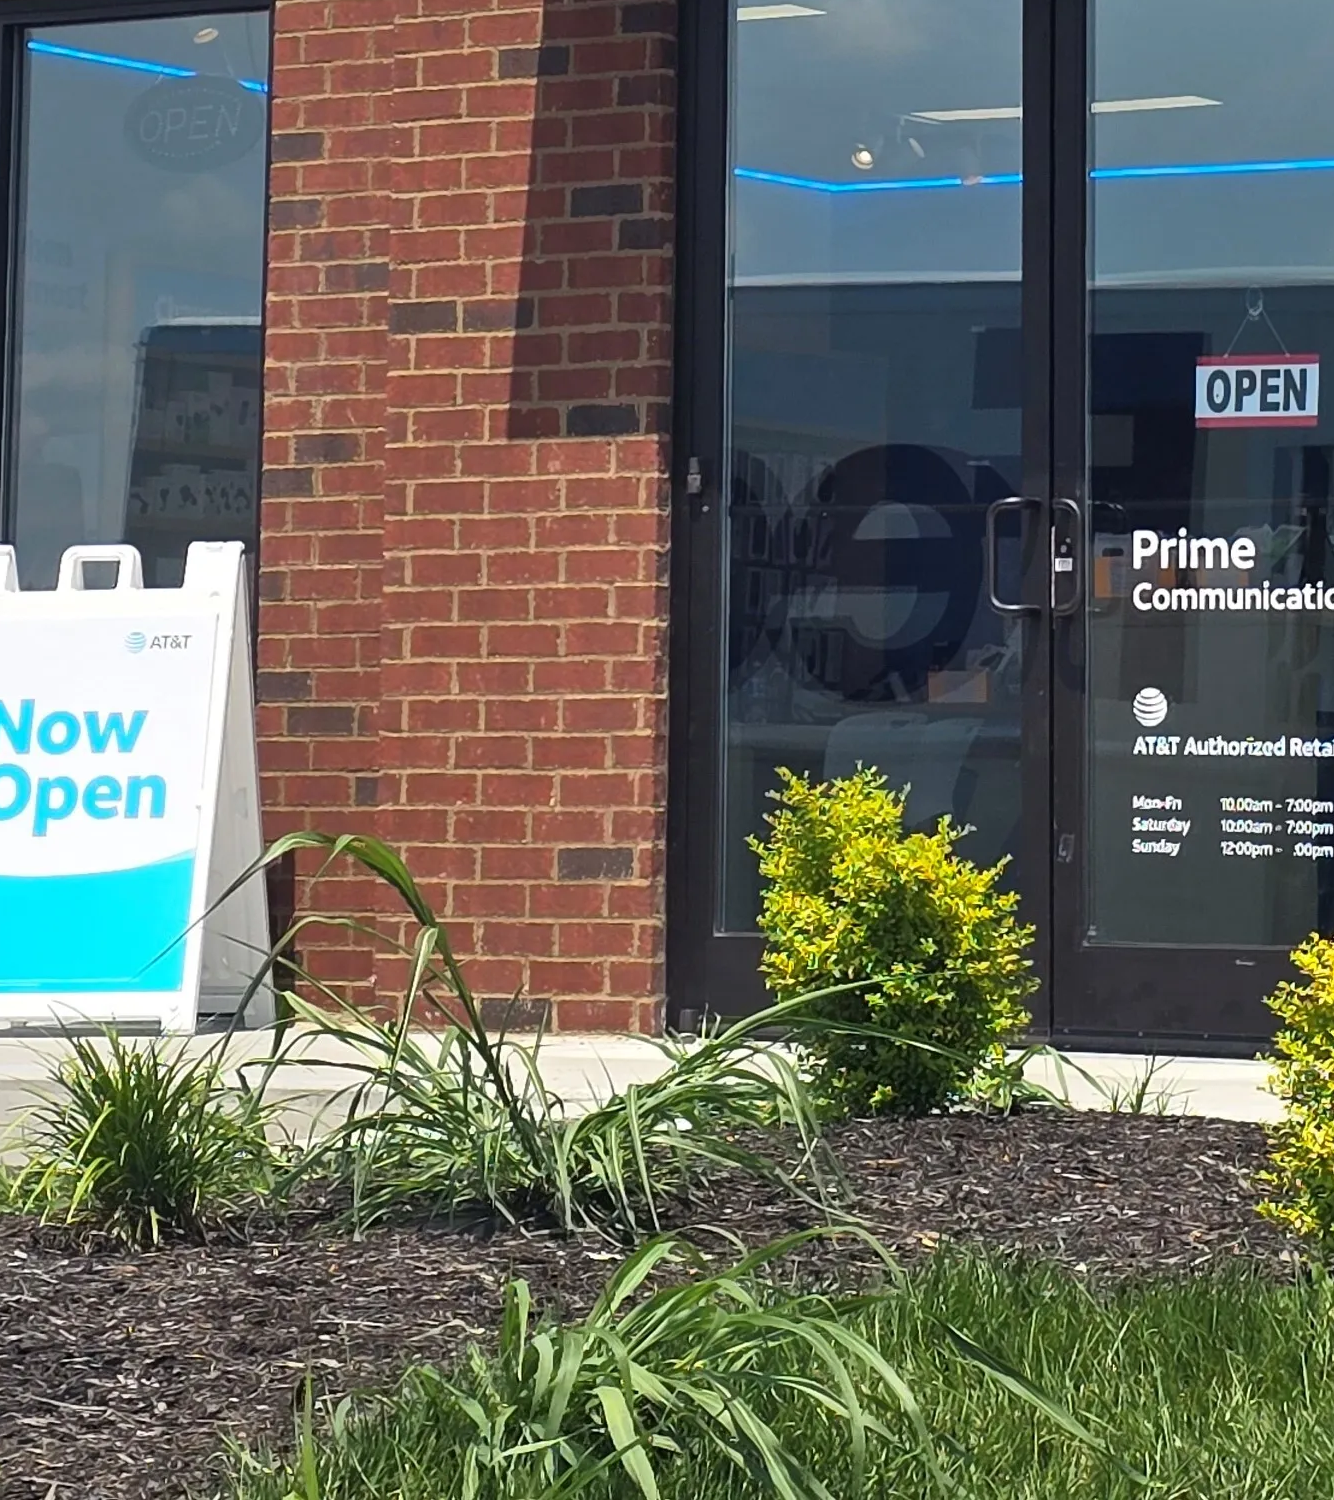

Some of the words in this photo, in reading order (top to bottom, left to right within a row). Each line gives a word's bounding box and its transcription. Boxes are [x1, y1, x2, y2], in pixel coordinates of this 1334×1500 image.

[140, 104, 243, 143] OPEN
[1206, 368, 1308, 413] OPEN
[1132, 527, 1256, 570] Prime
[150, 634, 192, 651] AT&T
[1133, 736, 1181, 756] AT&T
[1184, 734, 1286, 757] Authorized
[1132, 816, 1191, 837] Saturday
[1132, 838, 1181, 857] Sunday
